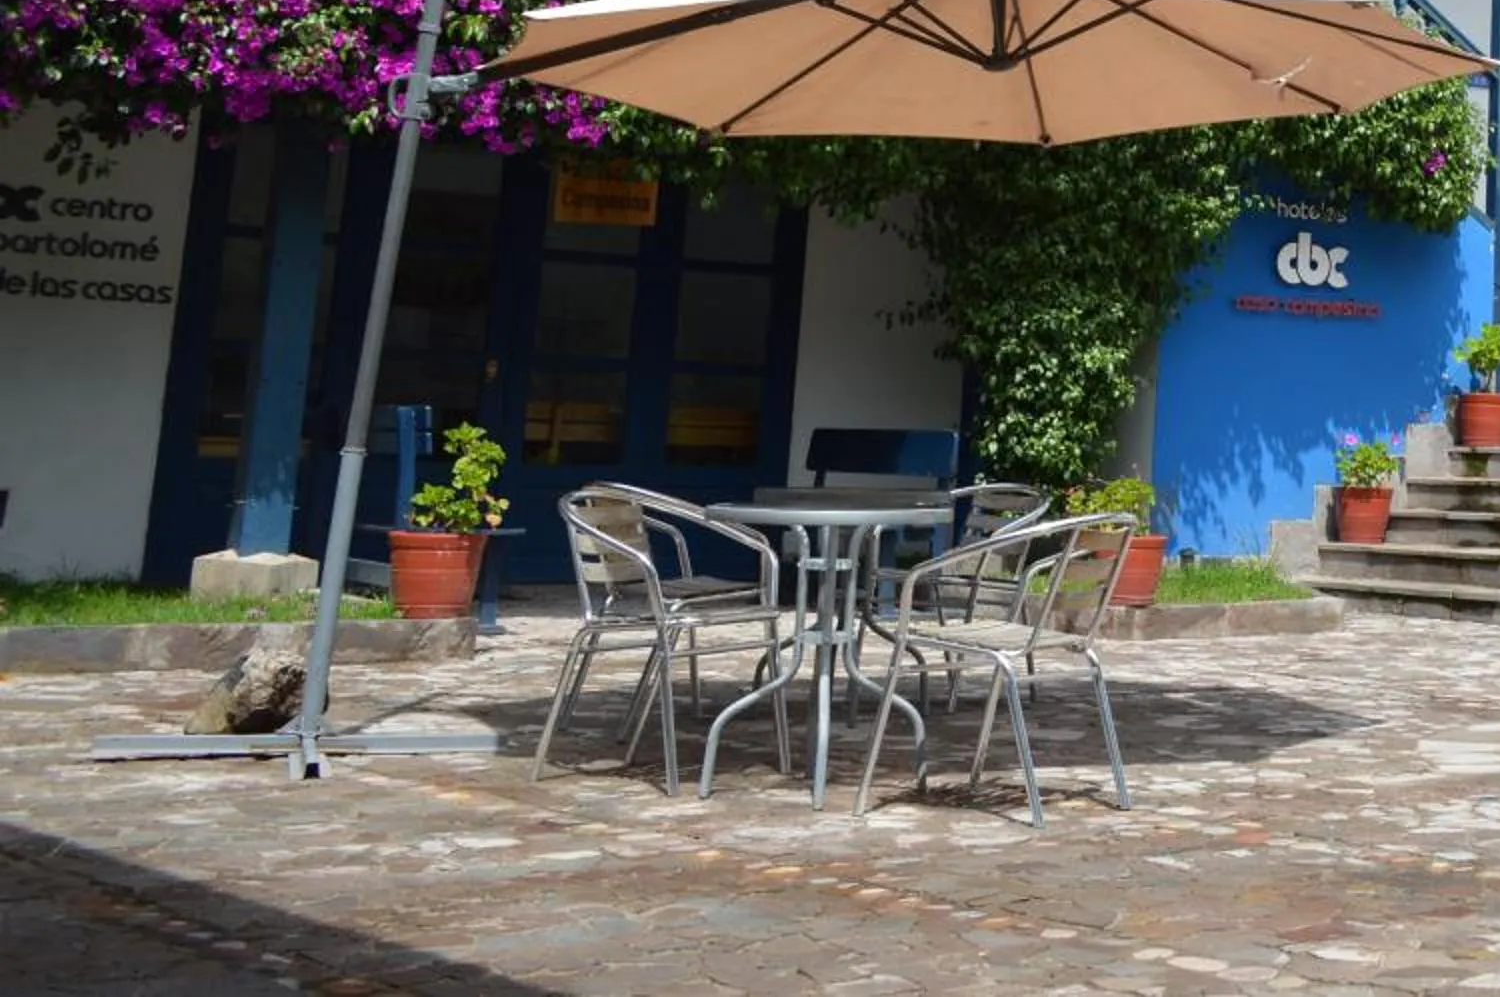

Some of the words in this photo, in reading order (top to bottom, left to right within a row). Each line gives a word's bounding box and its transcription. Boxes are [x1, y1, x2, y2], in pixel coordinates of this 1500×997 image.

[50, 196, 154, 222] centro
[30, 270, 79, 299] las
[81, 280, 175, 305] casas
